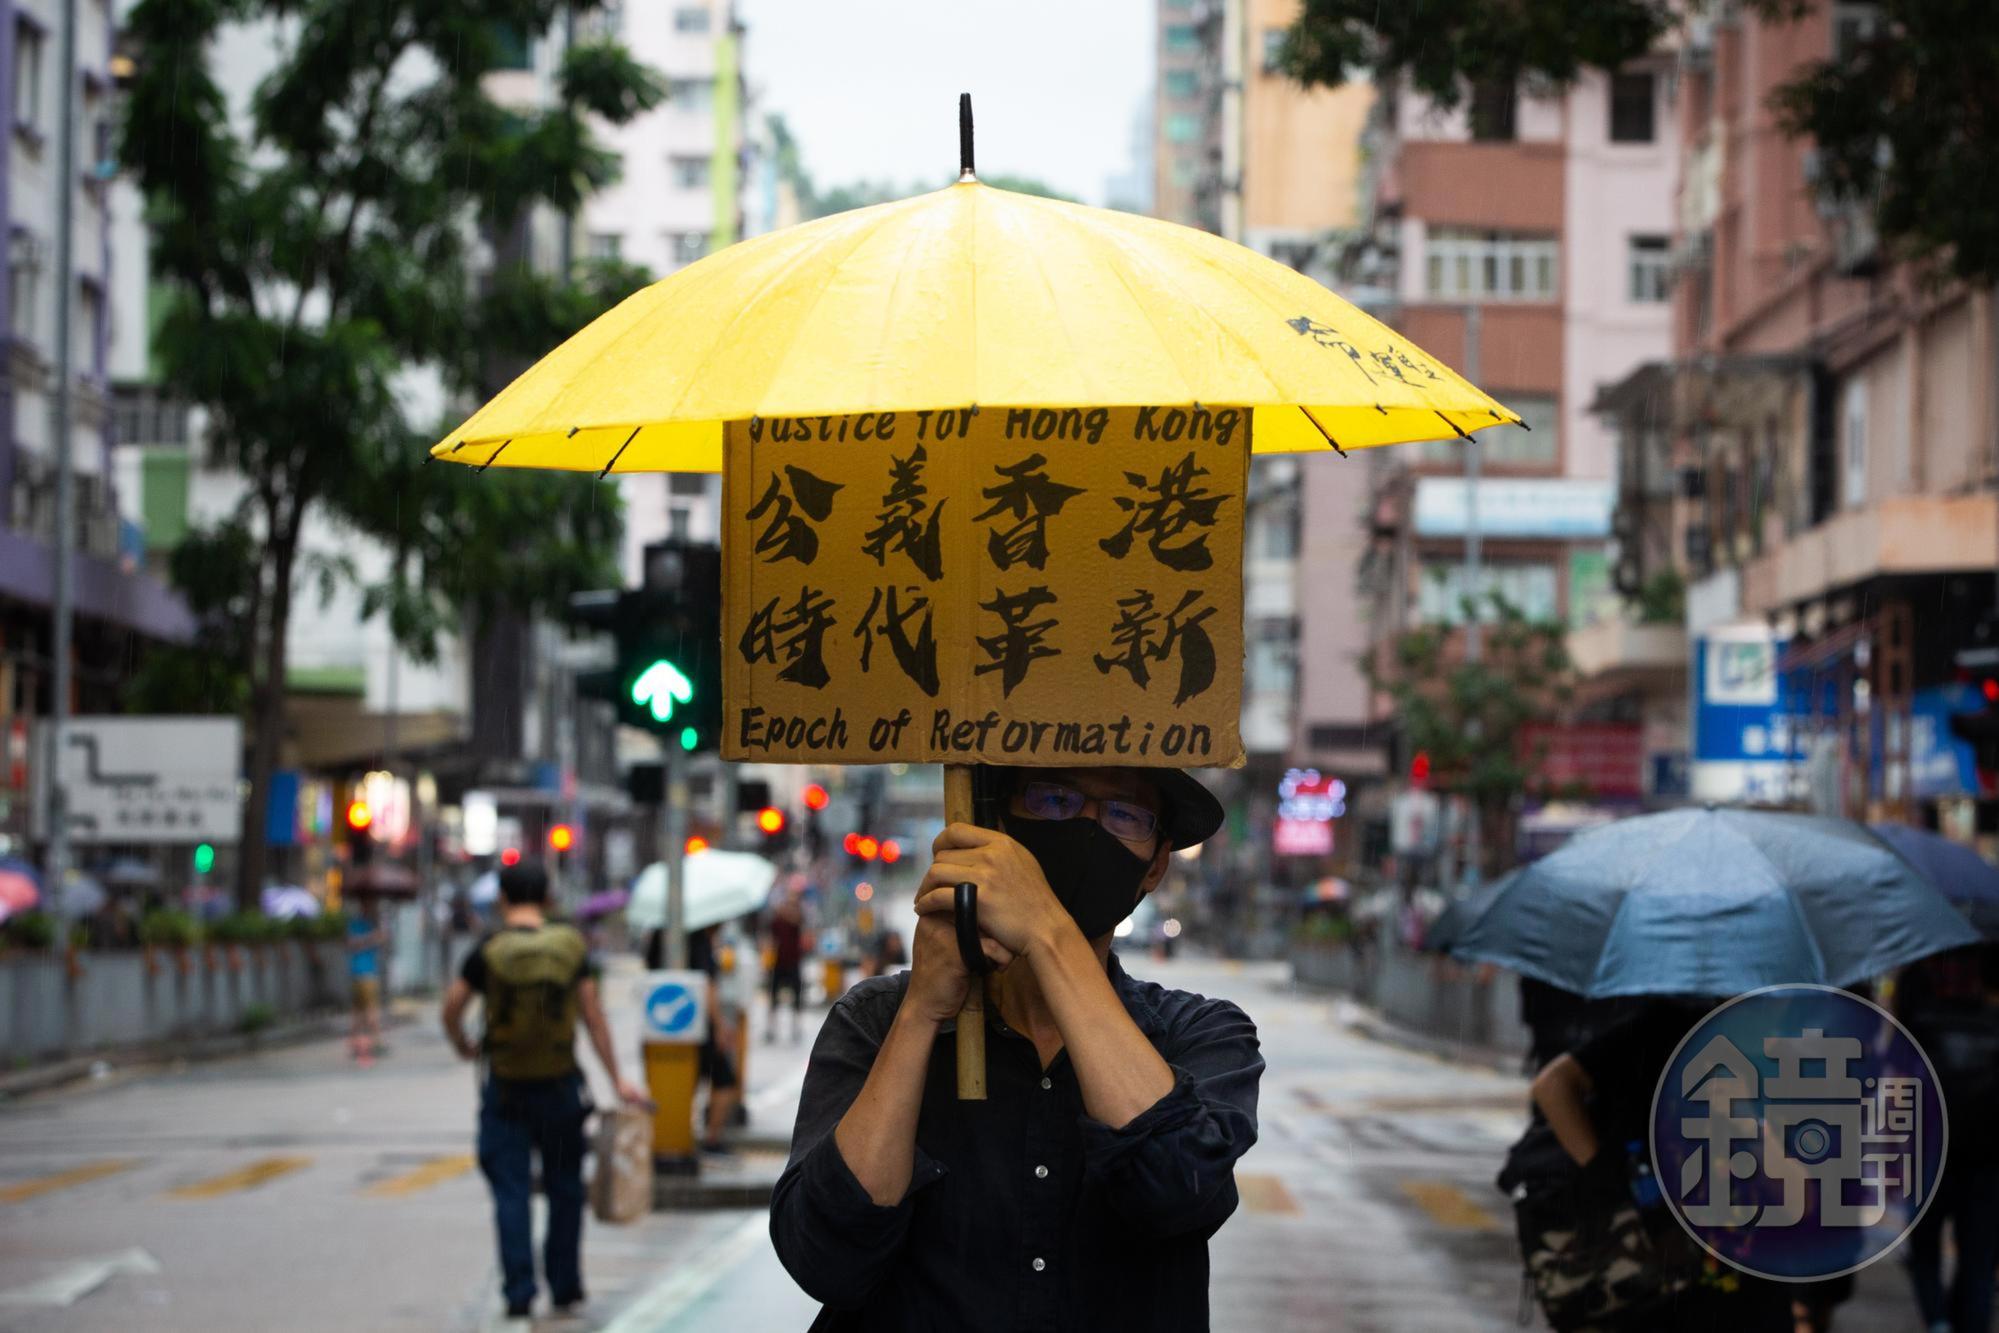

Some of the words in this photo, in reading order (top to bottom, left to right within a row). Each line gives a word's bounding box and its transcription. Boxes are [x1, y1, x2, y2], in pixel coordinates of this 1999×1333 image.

[750, 412, 895, 443] Justice
[917, 409, 974, 440] for
[1006, 408, 1109, 444] Hong
[1135, 407, 1240, 446] Kong
[746, 444, 1233, 582] 公義香港
[739, 585, 1218, 708] 時代革新
[740, 706, 848, 752] Epoch
[869, 709, 912, 752] of
[930, 709, 1211, 757] Reformation
